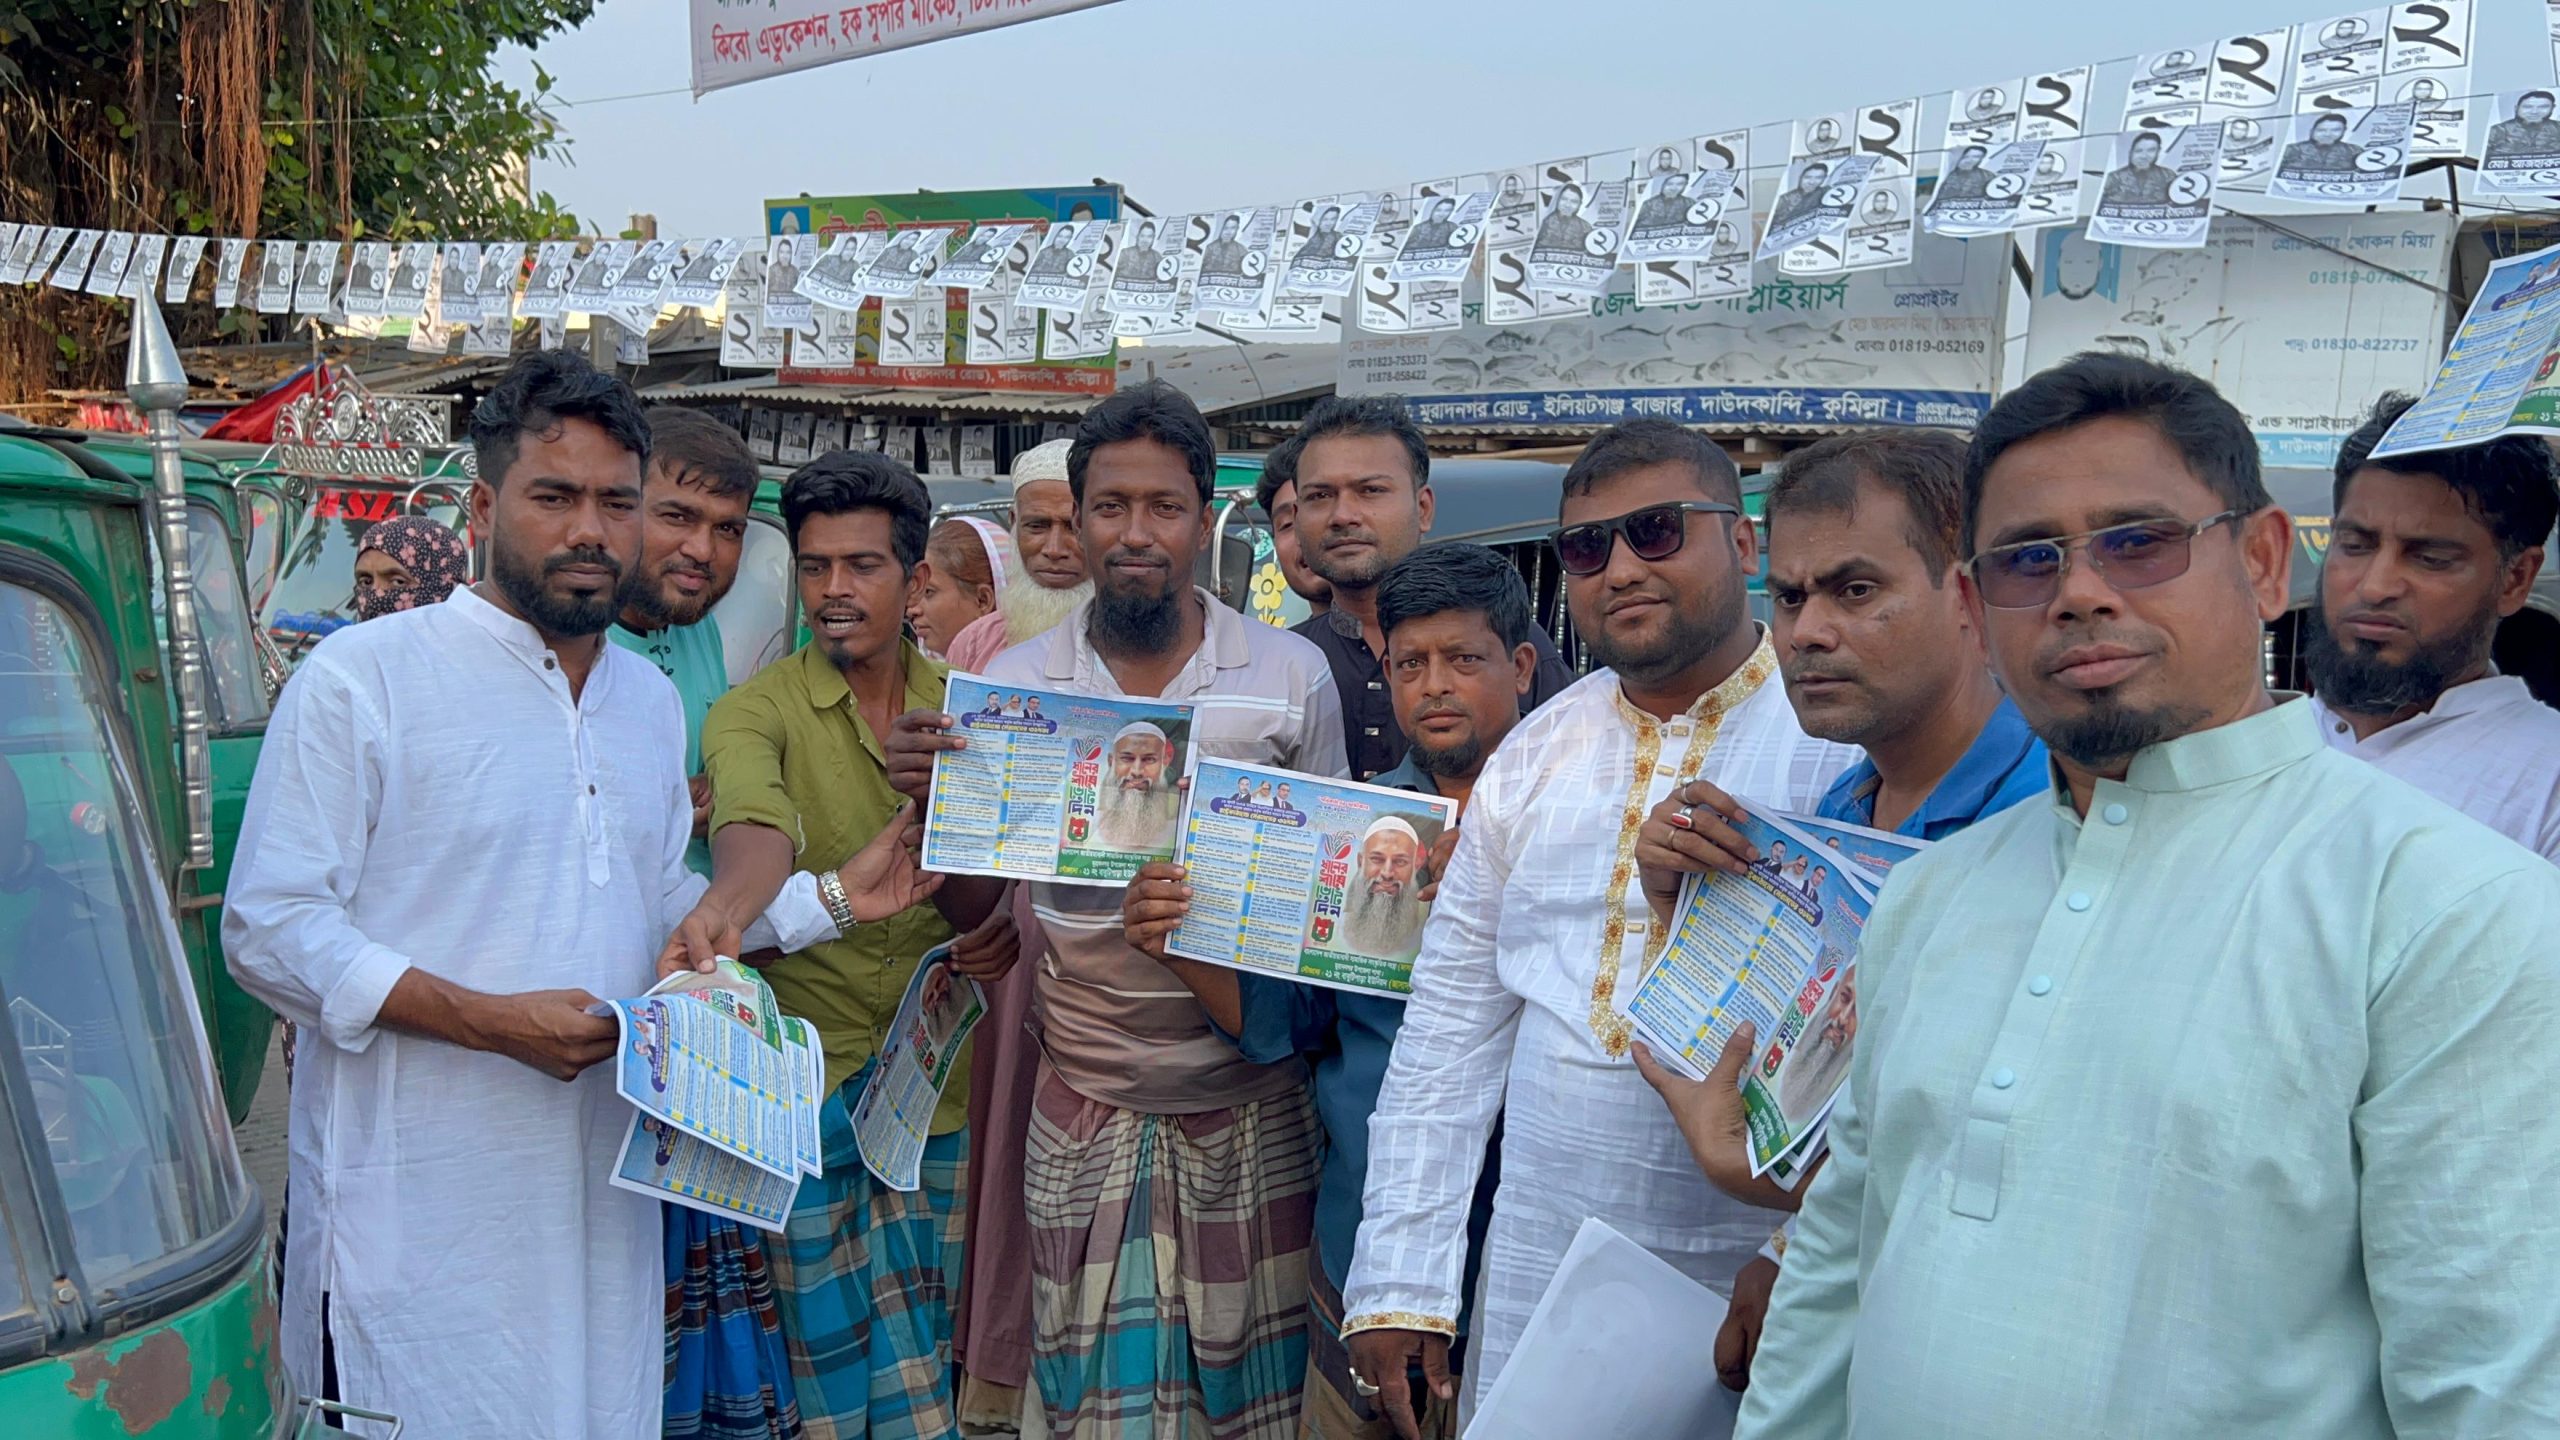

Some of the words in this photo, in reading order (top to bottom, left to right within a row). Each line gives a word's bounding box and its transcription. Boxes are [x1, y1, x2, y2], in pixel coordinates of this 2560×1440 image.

[712, 23, 751, 63] কিবো
[757, 14, 836, 65] এডুকেশন,
[839, 7, 862, 46] হক
[866, 0, 905, 42] সুপার
[2393, 4, 2462, 57] ২
[2218, 37, 2275, 95] ২
[2326, 56, 2359, 74] ২
[2155, 84, 2184, 98] ২
[2026, 77, 2078, 131] ২
[1859, 109, 1908, 168] ২
[1970, 129, 1995, 144] ২
[2413, 123, 2440, 145] ২
[2221, 158, 2253, 171] ২
[2367, 151, 2387, 166] ২
[1995, 177, 2011, 193] ২
[2178, 177, 2197, 199] ২
[1830, 188, 1845, 203] ২
[1695, 202, 1708, 220] ২
[2027, 196, 2057, 214] ২
[1505, 217, 1524, 235] ২
[1381, 233, 1399, 250] ২
[1456, 228, 1471, 243] ২
[1594, 231, 1607, 252] ২
[2401, 230, 2437, 250] মিয়া
[1341, 238, 1355, 255] ২
[1868, 236, 1892, 255] ২
[654, 265, 663, 278] ২
[716, 265, 725, 278] ২
[1073, 257, 1082, 273] ২
[1163, 258, 1174, 276] ২
[1248, 255, 1260, 273] ২
[551, 272, 558, 284] ২
[607, 271, 615, 284] ২
[1492, 253, 1534, 308] ২
[1715, 266, 1736, 286] ২
[1288, 305, 1306, 322] ২
[1427, 302, 1447, 320] ২
[728, 313, 756, 358] ২
[887, 309, 913, 355] ২
[974, 305, 1004, 352] ২
[1093, 330, 1106, 345] ২
[1018, 336, 1029, 352] ২
[1094, 330, 1106, 346] ২
[1889, 339, 1985, 354] 01819-052169
[2312, 338, 2419, 352] 01830-822737
[927, 341, 937, 357] ২
[1419, 401, 1488, 423] মুরাদনগর
[1493, 399, 1538, 421] রোড,
[1543, 393, 1626, 418] ইলিয়টগঞ্জ
[1631, 395, 1693, 419] বাজার,
[1698, 390, 1814, 421] দাউদকান্দি,
[1821, 391, 1893, 421] কুমিল্লা
[1313, 899, 1342, 918] দিন
